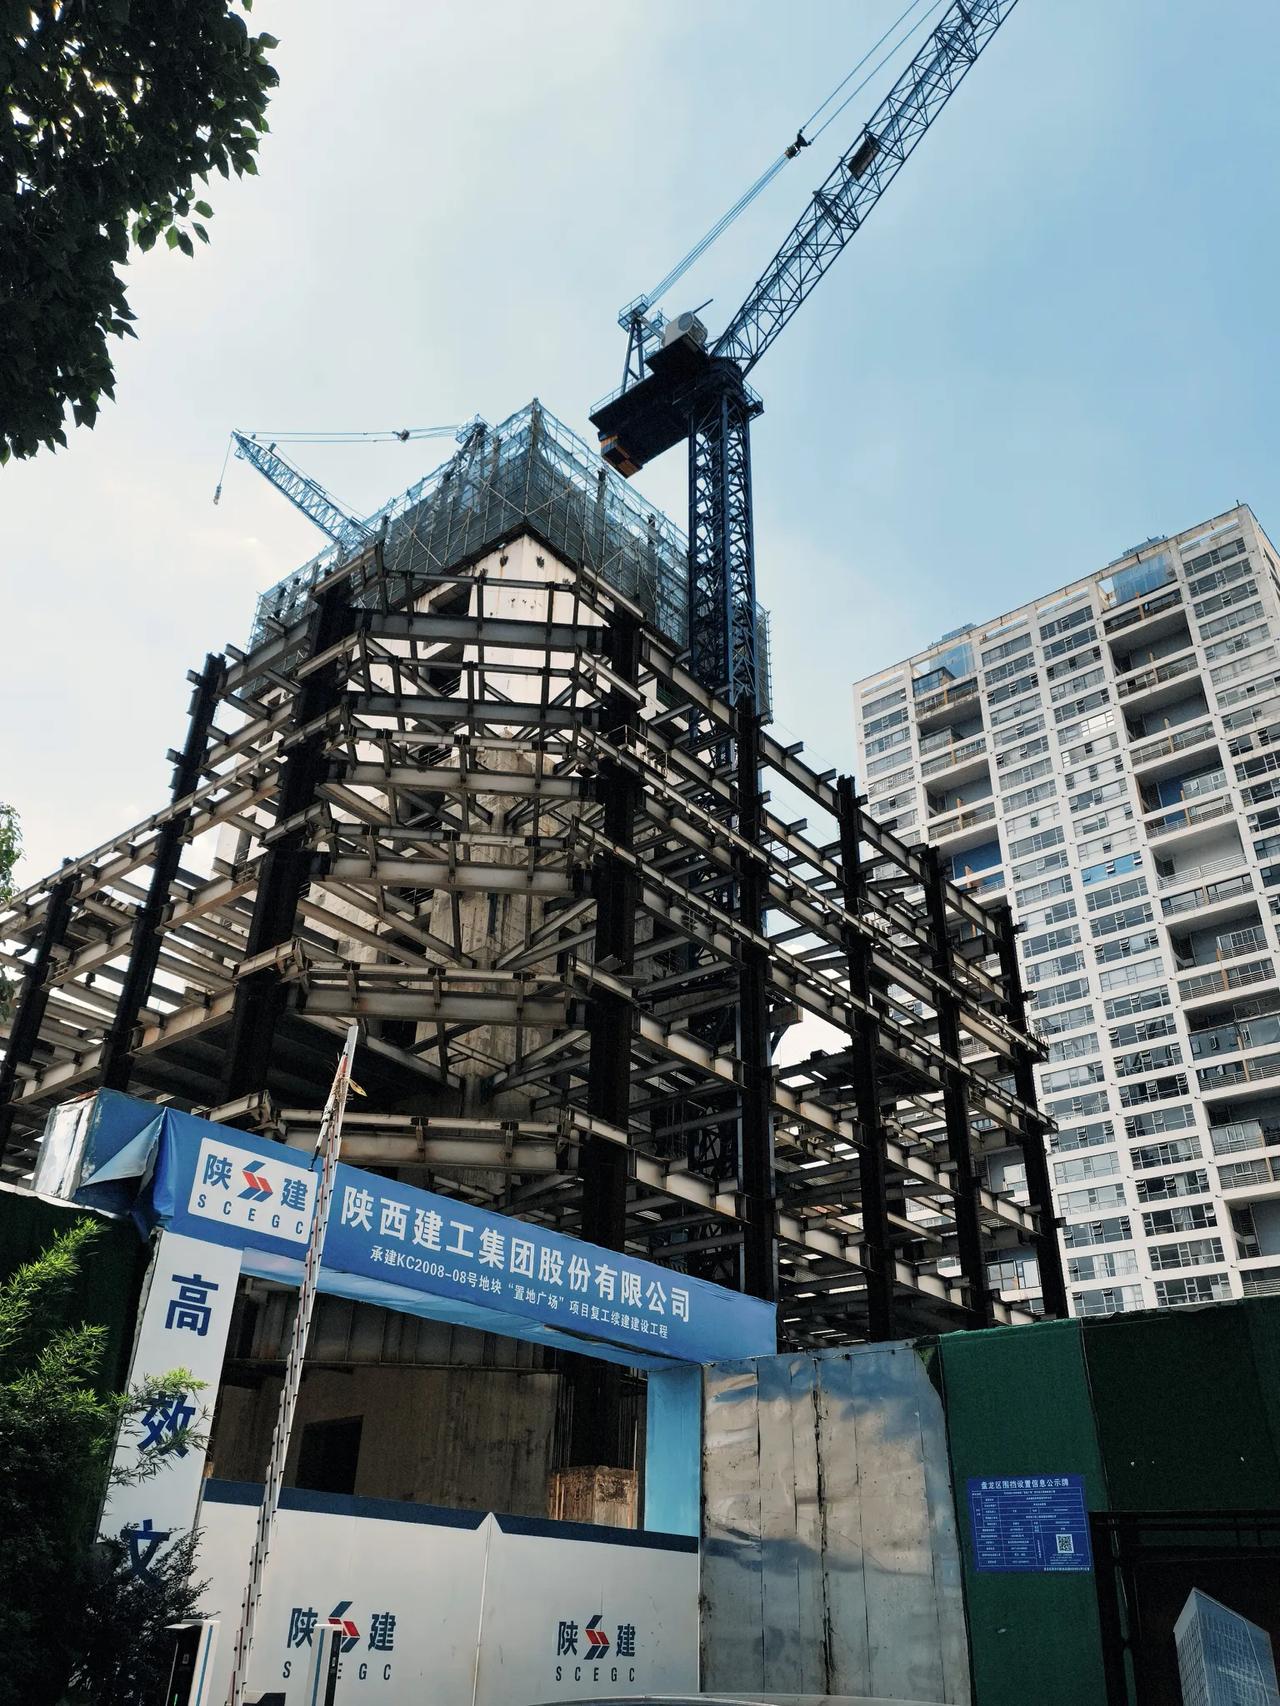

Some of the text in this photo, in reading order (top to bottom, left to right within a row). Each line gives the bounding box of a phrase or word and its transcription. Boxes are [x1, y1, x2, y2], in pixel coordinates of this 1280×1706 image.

[197, 1193, 304, 1235] SCEGC
[340, 1185, 690, 1323] 陕西建工集团股份有限公司
[555, 1665, 635, 1683] SCEGC
